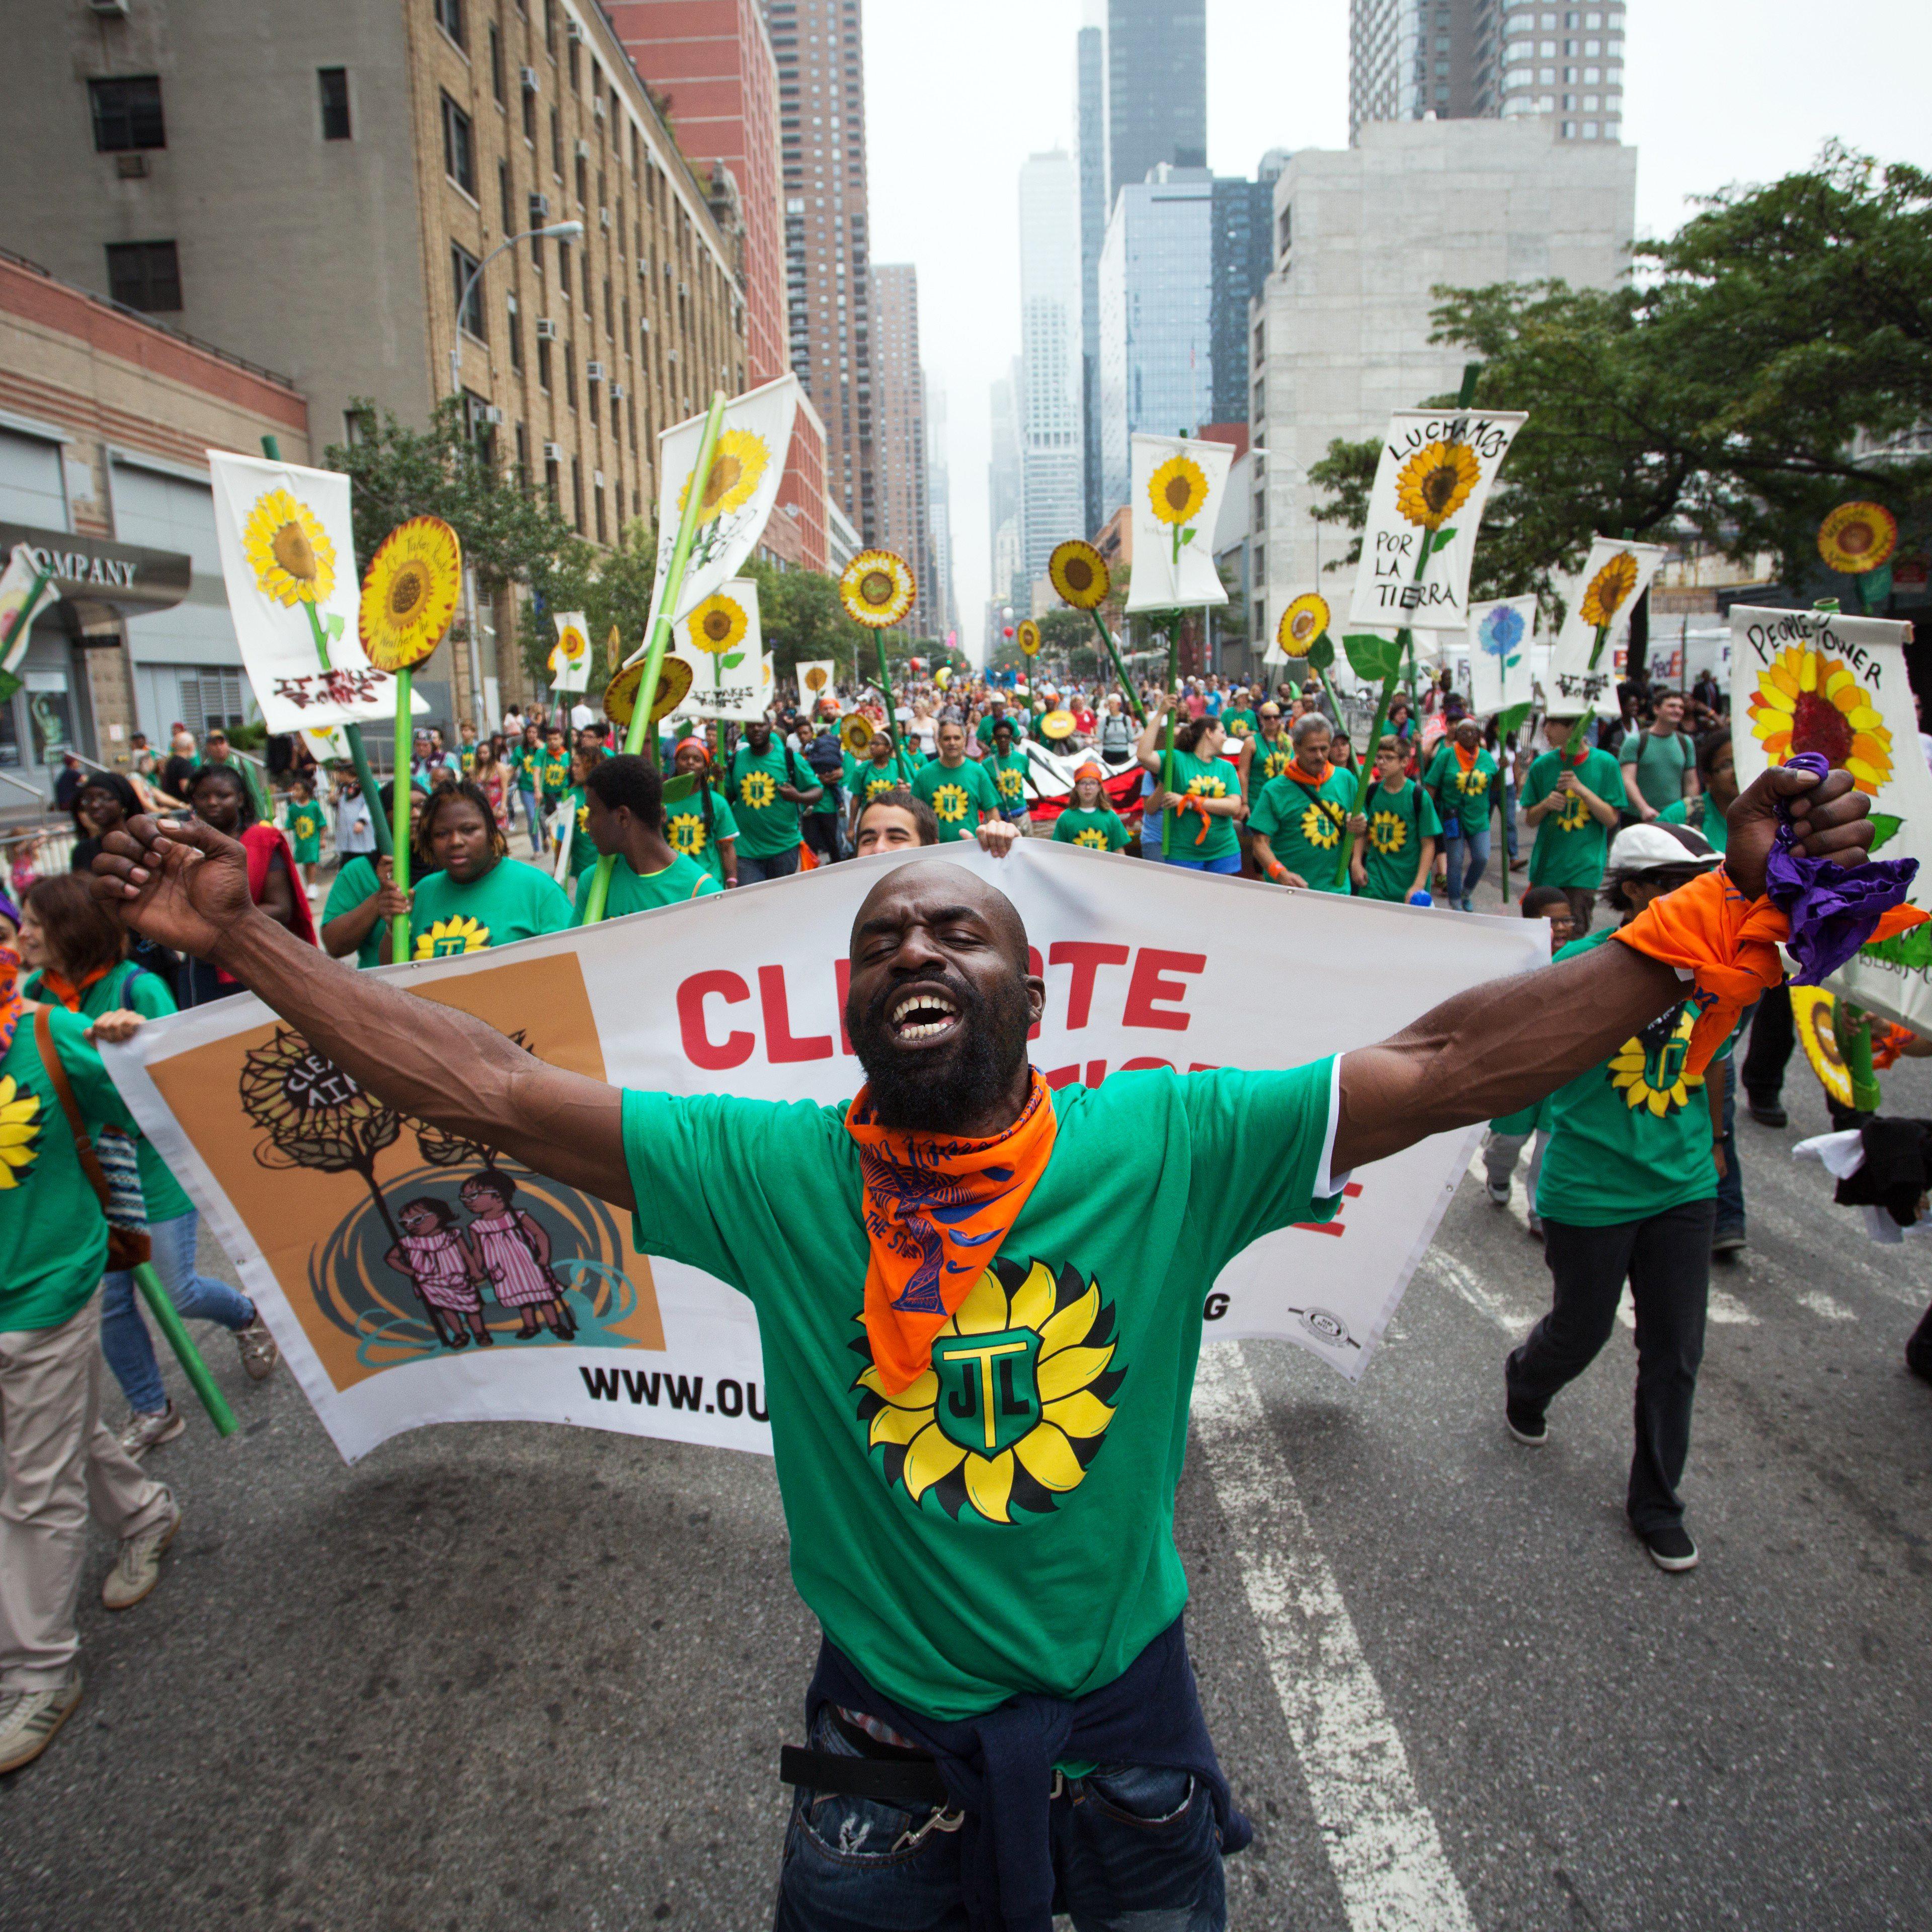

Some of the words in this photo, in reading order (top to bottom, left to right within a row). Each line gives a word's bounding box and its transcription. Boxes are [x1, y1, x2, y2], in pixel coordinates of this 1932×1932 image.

[1389, 418, 1508, 461] LUCHAMOS
[1377, 531, 1412, 557] POR
[31, 546, 137, 590] OMPANY
[1376, 557, 1402, 579] LA
[1375, 582, 1459, 609] TIERRA
[1747, 614, 1812, 665] PEOPLE
[676, 941, 1206, 1071] CLITE
[288, 1055, 334, 1092] CLE
[865, 1210, 892, 1239] THE
[943, 1341, 1030, 1448] JTL
